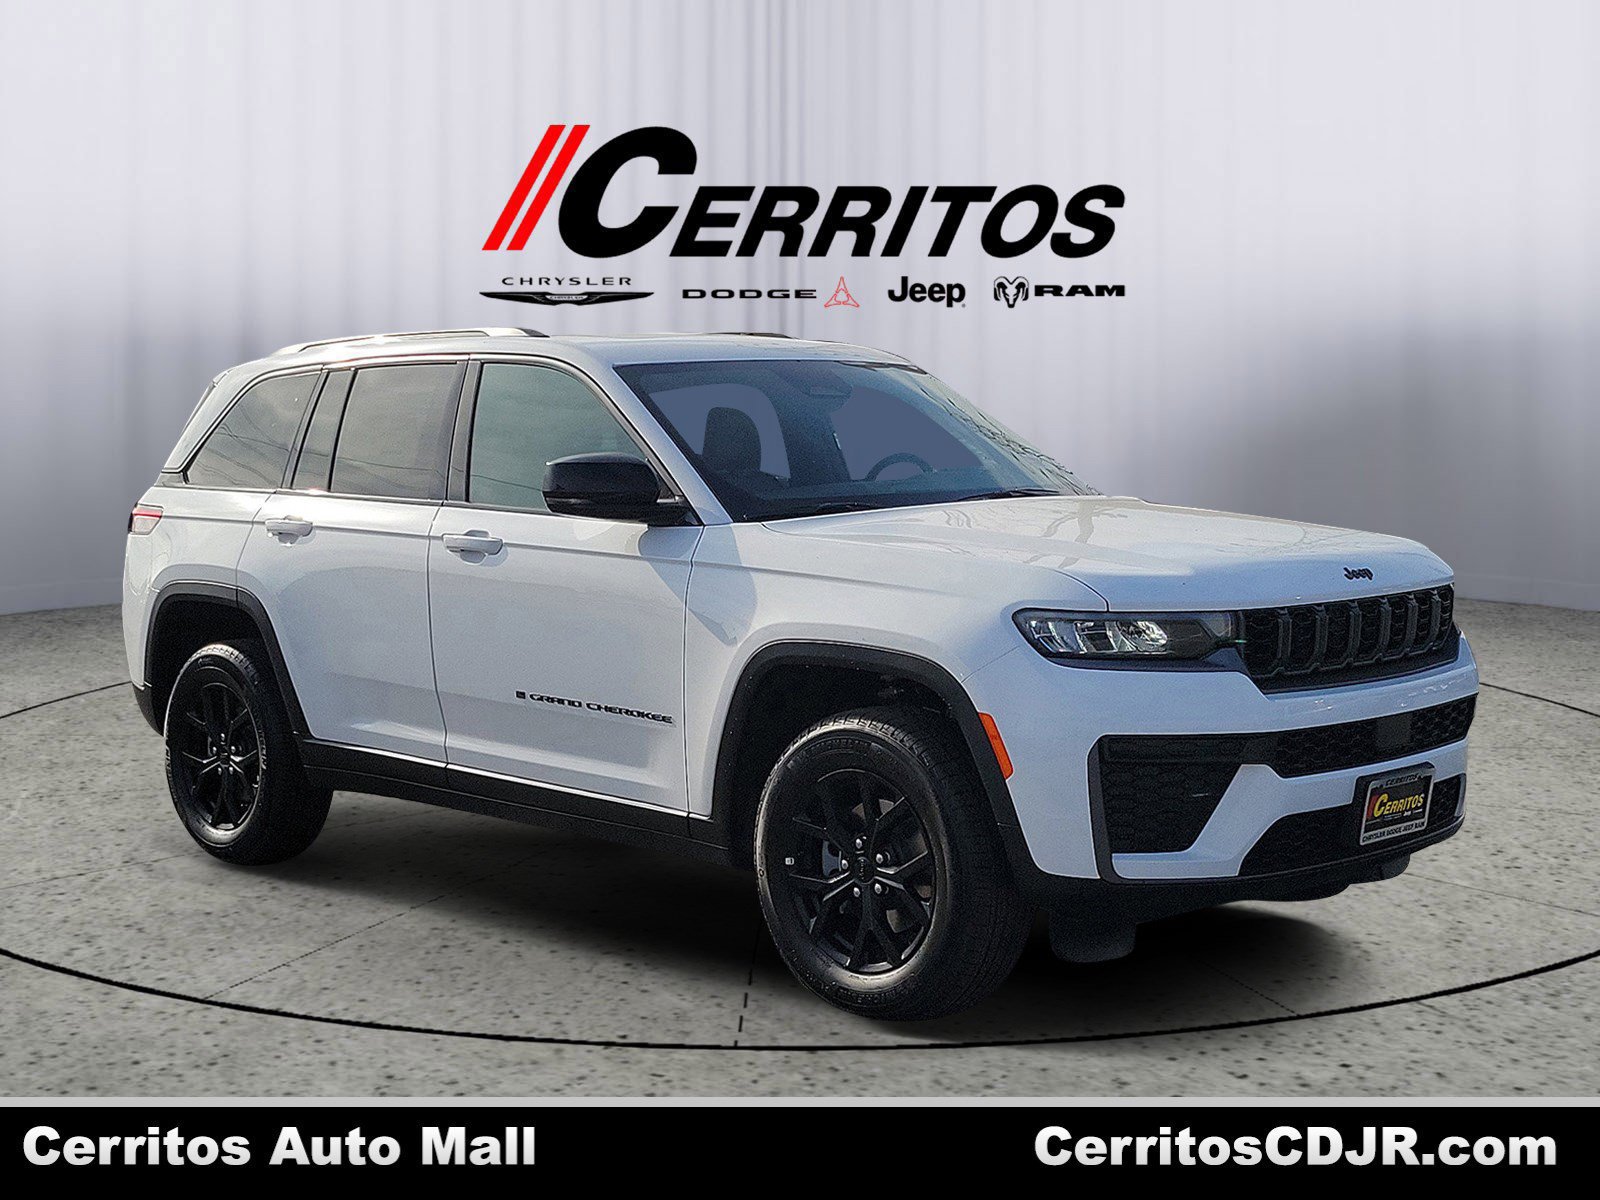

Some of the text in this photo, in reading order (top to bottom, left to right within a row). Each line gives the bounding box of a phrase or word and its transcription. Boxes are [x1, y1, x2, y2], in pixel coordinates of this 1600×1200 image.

[1343, 567, 1374, 581] Jeep
[529, 693, 583, 708] GRAND
[586, 702, 673, 724] CHEROKEE
[1374, 793, 1425, 817] CERRITOS
